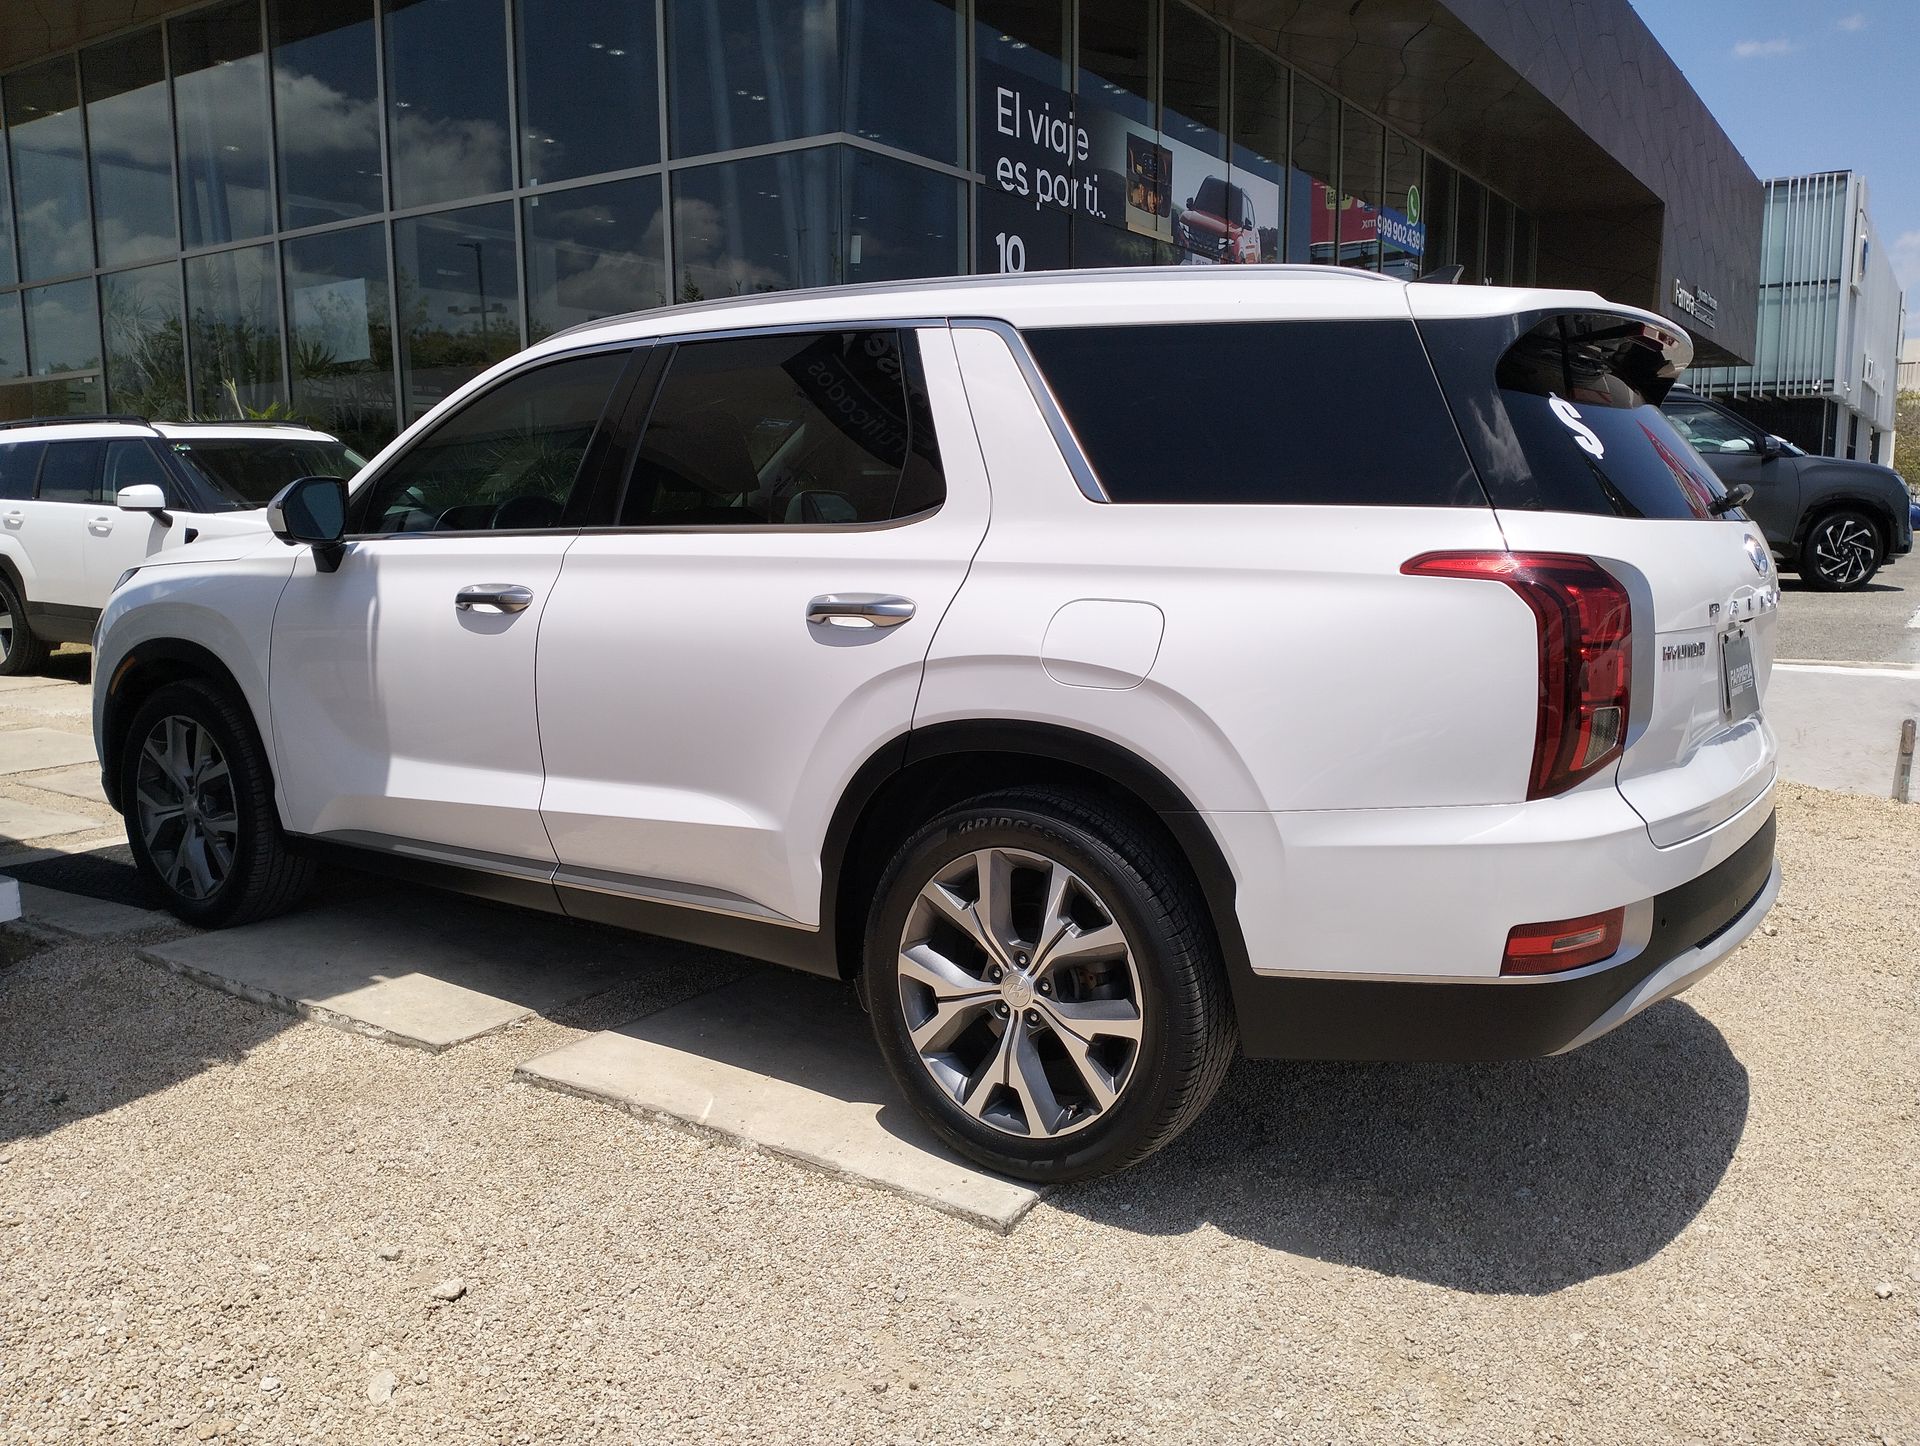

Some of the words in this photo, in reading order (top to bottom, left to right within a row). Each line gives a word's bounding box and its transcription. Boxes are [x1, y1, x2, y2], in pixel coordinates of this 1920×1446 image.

[996, 86, 1020, 138] El
[1028, 102, 1089, 167] viaje
[996, 156, 1030, 196] es
[1036, 168, 1078, 211] por
[995, 232, 1026, 274] 10
[1392, 222, 1407, 245] 902
